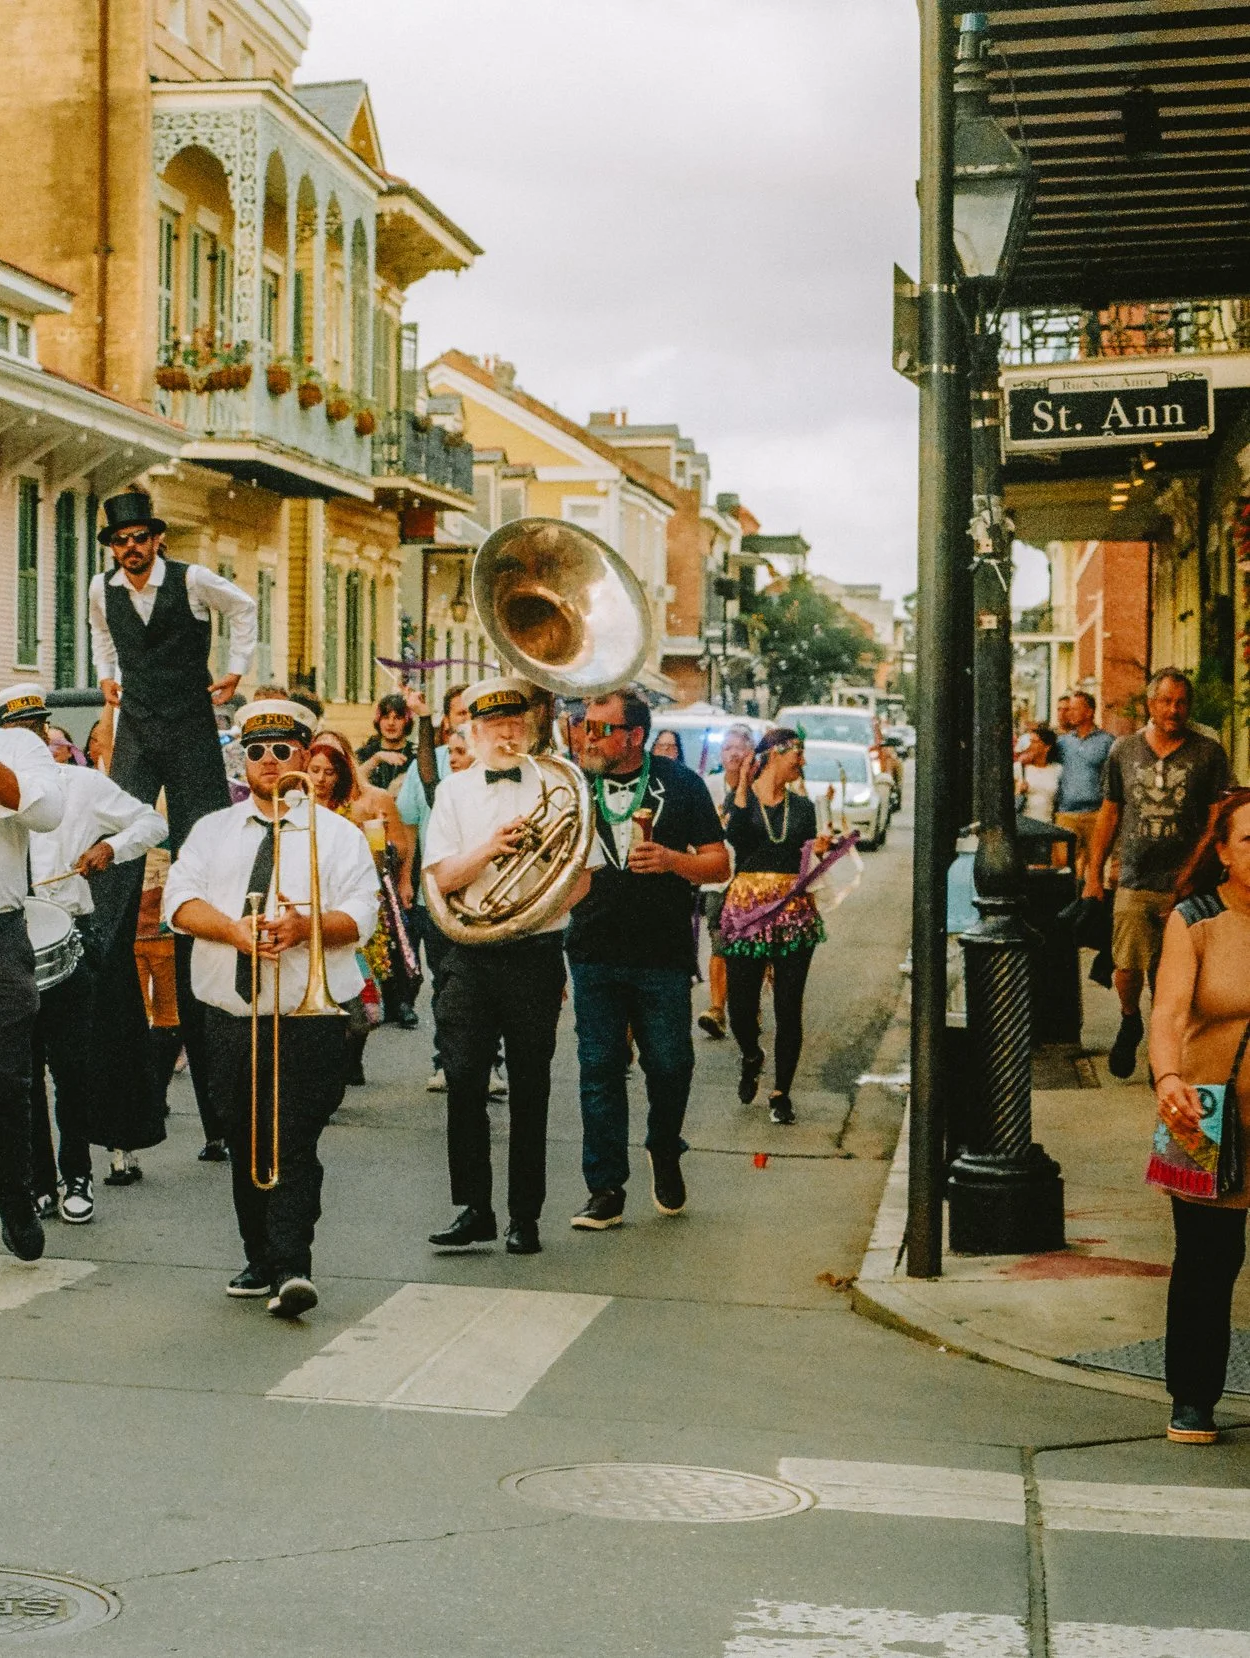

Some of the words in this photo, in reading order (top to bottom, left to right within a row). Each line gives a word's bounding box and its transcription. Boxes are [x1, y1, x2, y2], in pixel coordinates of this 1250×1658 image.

[1032, 400, 1083, 432] St.
[1100, 397, 1186, 429] Ann
[265, 713, 293, 727] FUN
